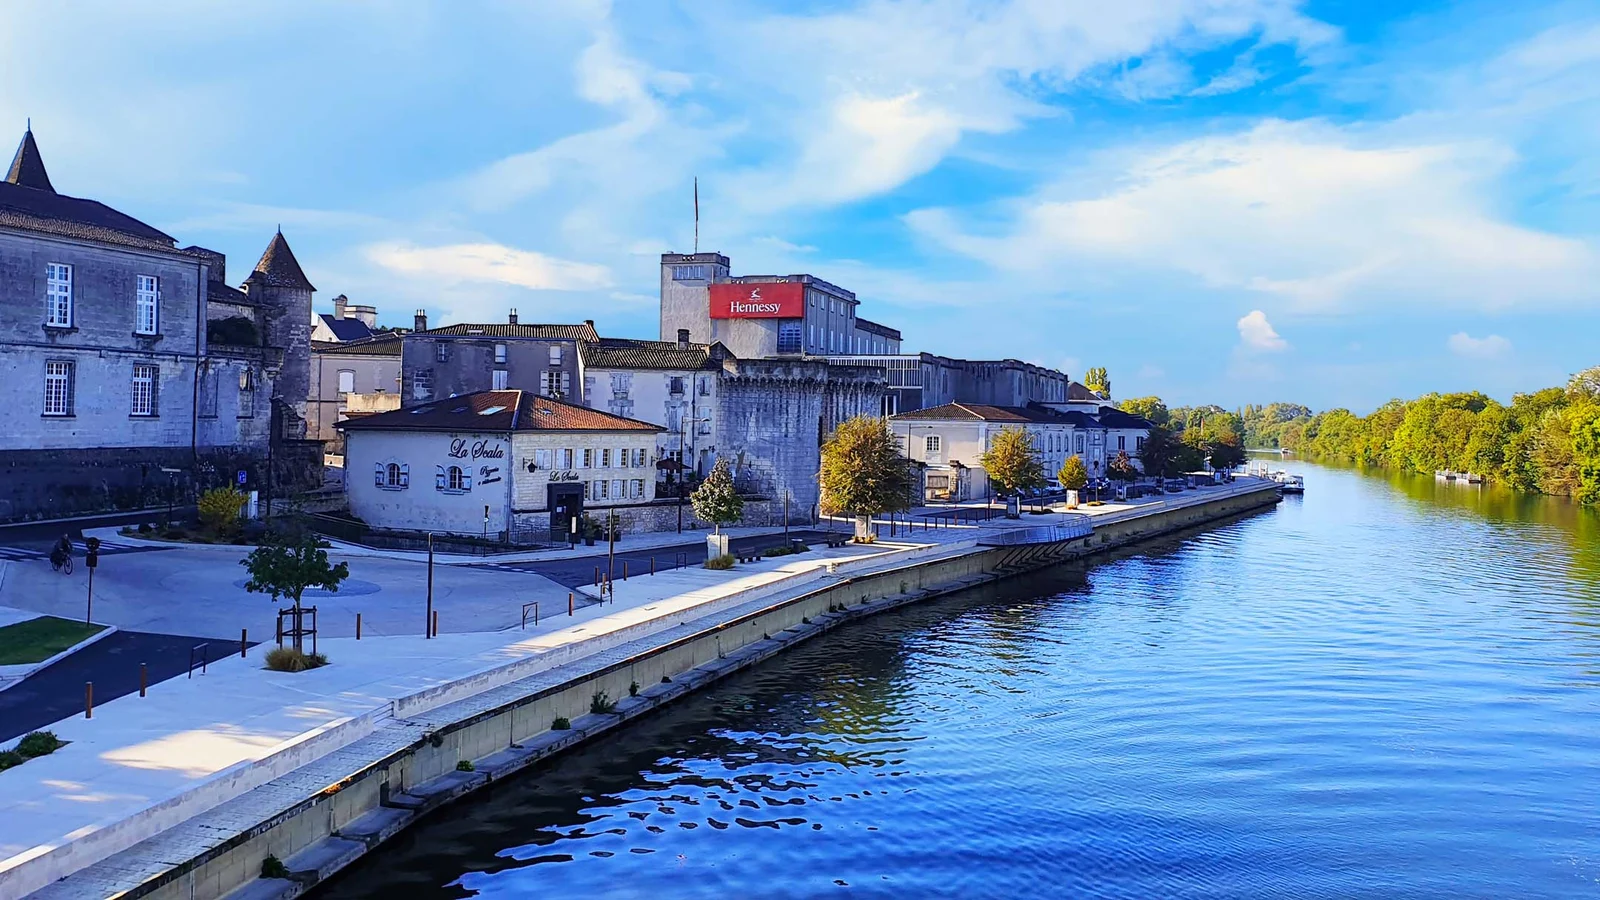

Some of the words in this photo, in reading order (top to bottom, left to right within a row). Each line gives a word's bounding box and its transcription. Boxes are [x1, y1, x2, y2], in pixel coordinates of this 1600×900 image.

[730, 301, 781, 314] Hennessy
[448, 438, 469, 459] La
[471, 439, 504, 462] Scala
[549, 470, 560, 481] La
[561, 470, 579, 482] Scala
